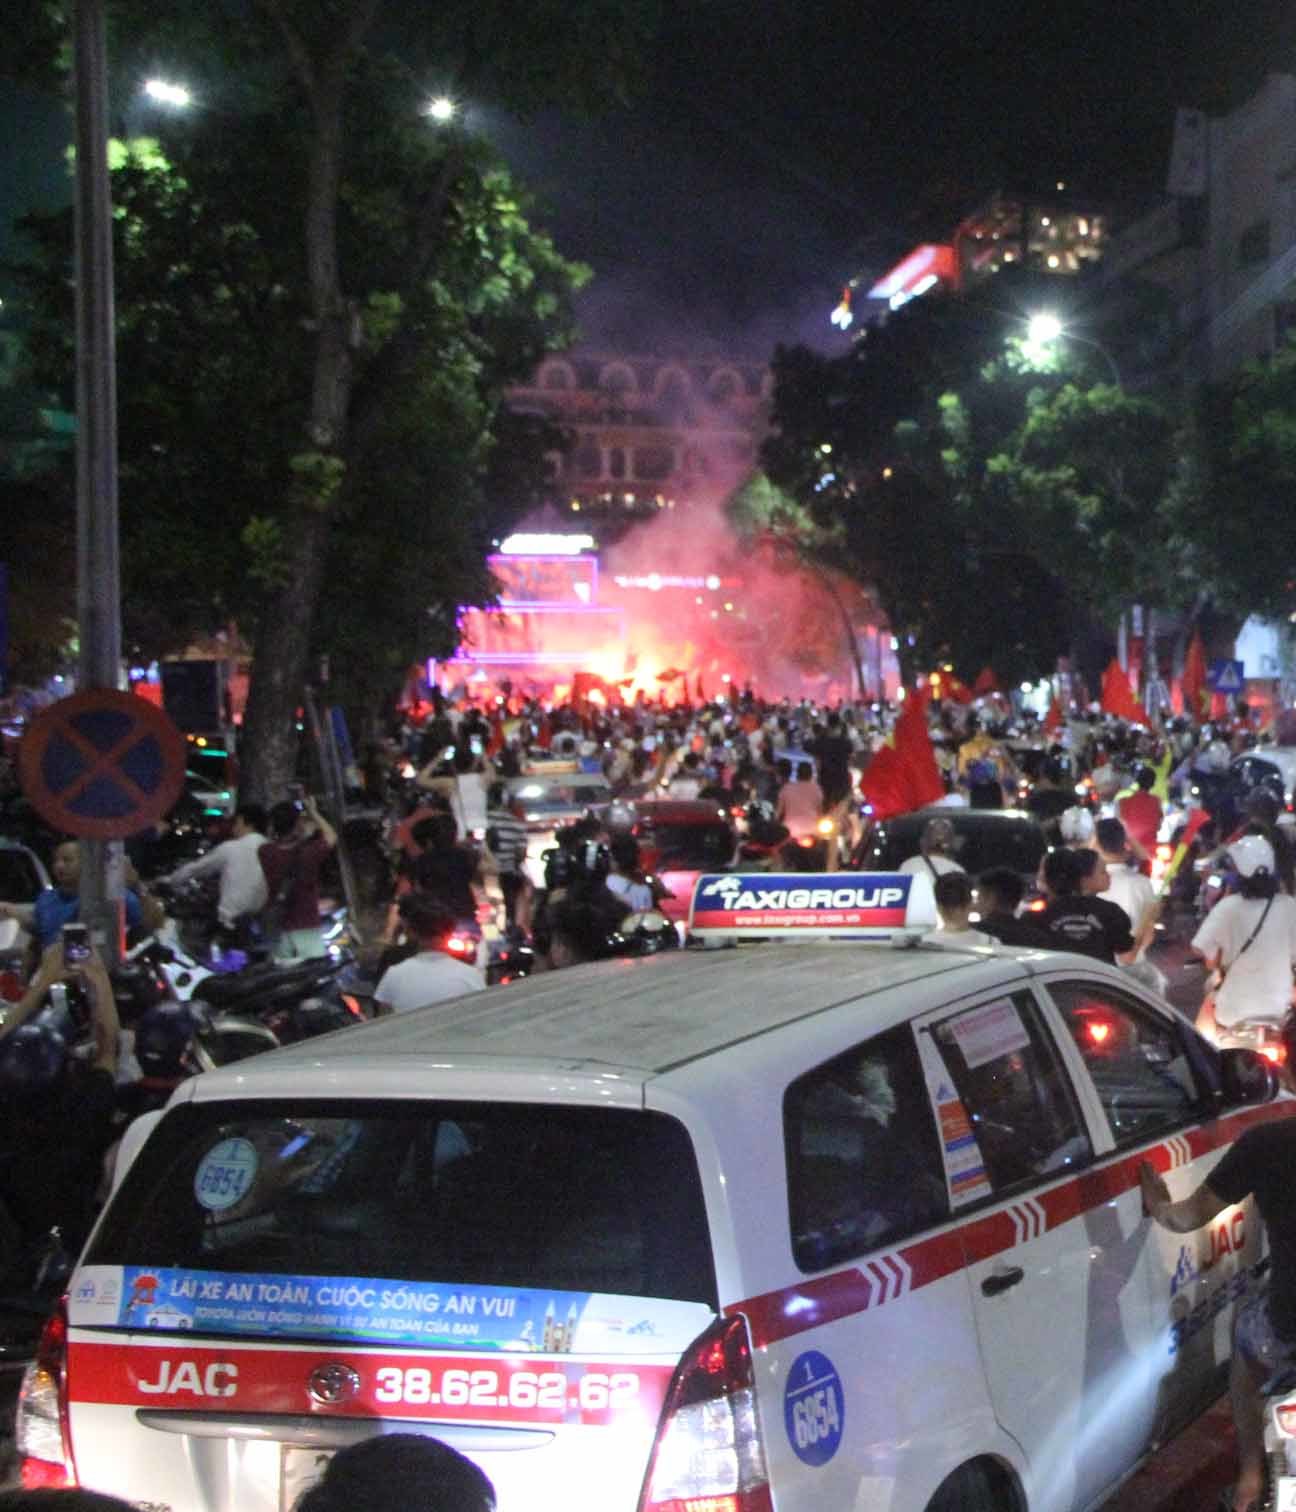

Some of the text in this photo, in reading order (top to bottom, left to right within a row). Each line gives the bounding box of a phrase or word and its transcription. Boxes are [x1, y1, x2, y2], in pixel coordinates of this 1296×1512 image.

[721, 887, 903, 910] TAXIGROUP
[1201, 1210, 1246, 1271] JAC
[199, 1281, 223, 1299] XE
[225, 1284, 254, 1301] AN
[381, 1286, 439, 1312] SỐNG
[443, 1295, 476, 1316] AN
[480, 1297, 516, 1317] VUI
[137, 1360, 239, 1397] JAC
[374, 1366, 640, 1409] 38.62.62.62
[803, 1361, 815, 1380] 1
[793, 1386, 839, 1448] 6854
